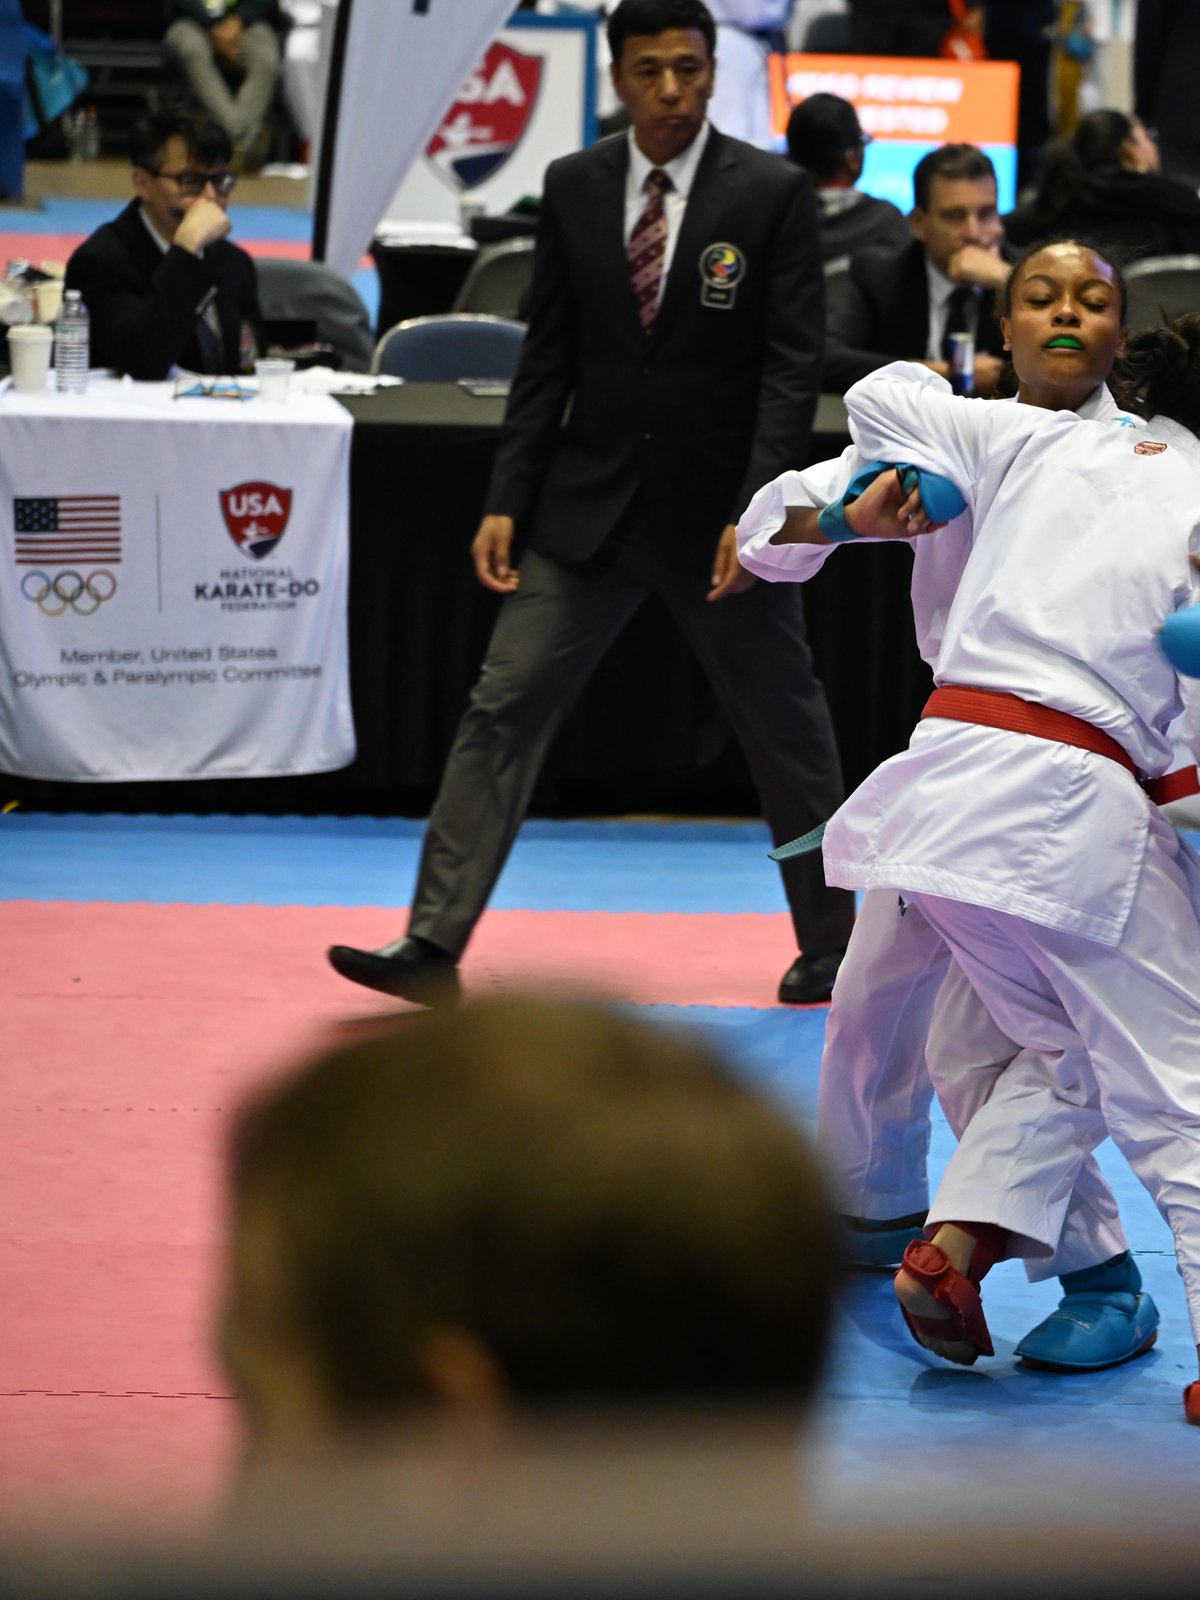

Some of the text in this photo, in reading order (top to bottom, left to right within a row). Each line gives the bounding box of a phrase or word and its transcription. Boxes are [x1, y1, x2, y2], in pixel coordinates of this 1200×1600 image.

[229, 494, 282, 517] USA
[195, 579, 319, 600] KARATE-DO
[60, 645, 278, 664] Member, United States
[15, 666, 322, 689] Olympic & Paralympic Committee
